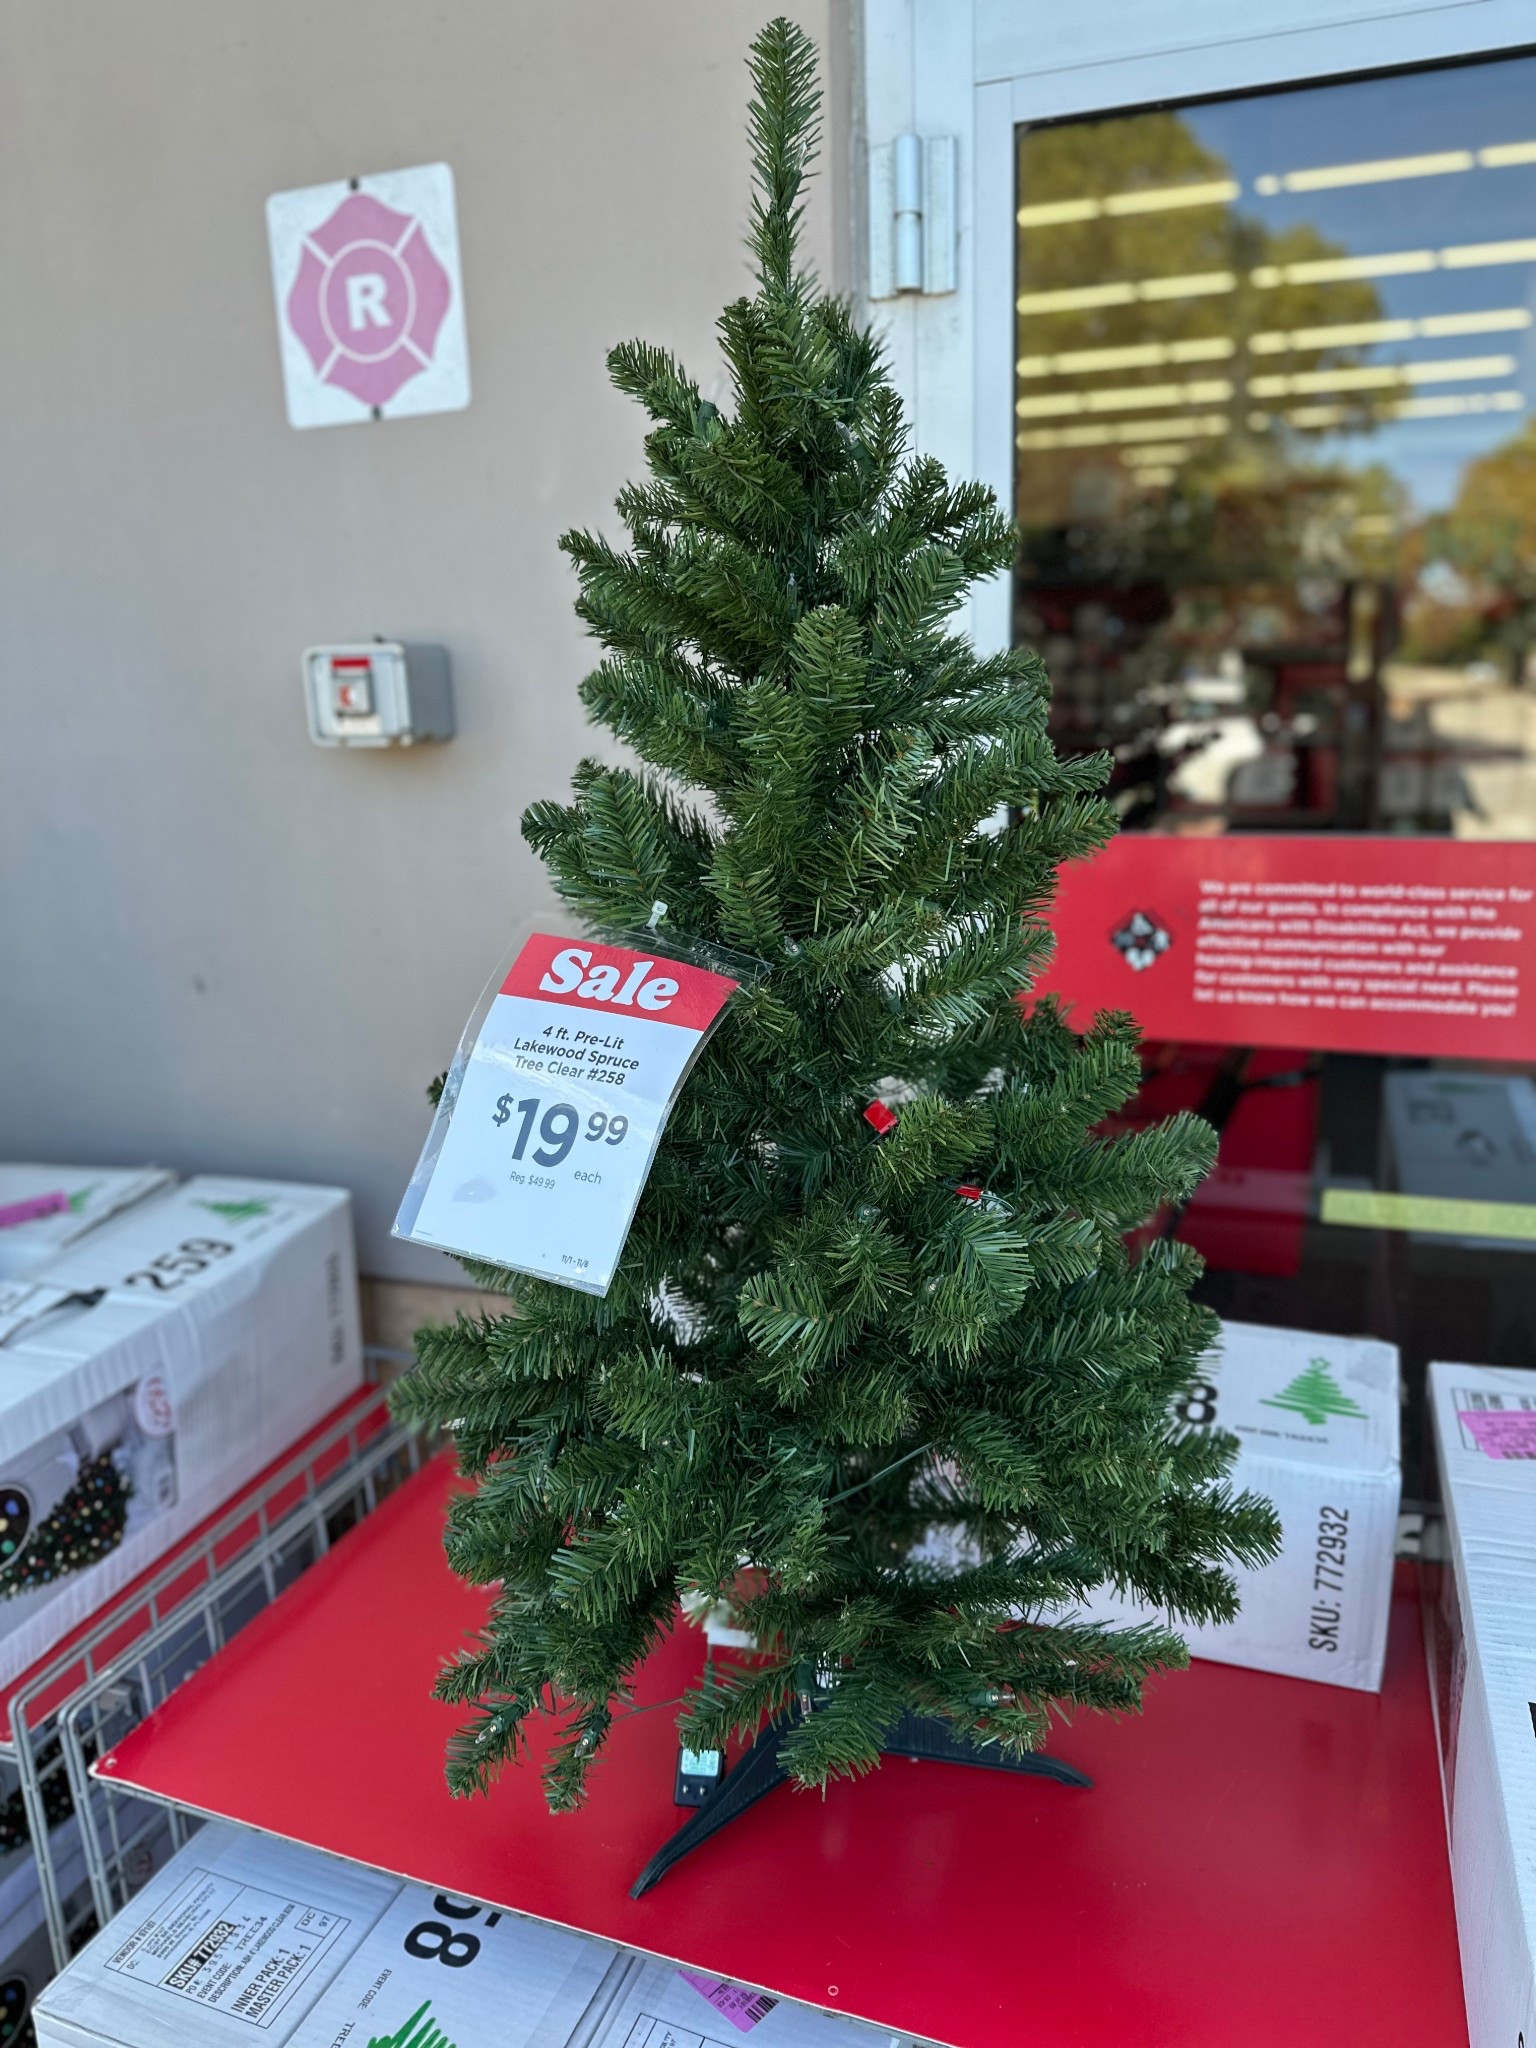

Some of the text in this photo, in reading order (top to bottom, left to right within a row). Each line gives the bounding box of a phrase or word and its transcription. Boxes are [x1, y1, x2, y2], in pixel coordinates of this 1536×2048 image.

[347, 273, 392, 331] R
[539, 948, 680, 1011] Sale
[543, 1026, 624, 1050] 4 ft. Pre-Lit
[514, 1038, 640, 1070] Lakewood Spruce
[515, 1055, 626, 1085] Tree Clear #258
[510, 1171, 525, 1185] Reg.
[574, 1170, 602, 1184] each
[123, 1238, 235, 1291] 259
[1309, 1506, 1349, 1653] SKU: 772932
[300, 1912, 315, 1926] DC
[318, 1915, 330, 1927] 97
[112, 1940, 138, 1963] VENDOR
[169, 1959, 201, 1987] SKU#
[193, 1923, 233, 1958] 772932
[185, 1985, 196, 1994] PO
[196, 1979, 216, 1998] EVENT
[212, 1962, 232, 1980] CODE:
[207, 1964, 245, 2003] DESCRIPTION:
[230, 1982, 262, 2012] INNER
[254, 1956, 284, 1983] PACK:
[245, 1978, 284, 2018] MASTER
[276, 1952, 306, 1979] PACK:
[373, 1968, 392, 1991] EVENT
[357, 1989, 377, 2010] CODE:
